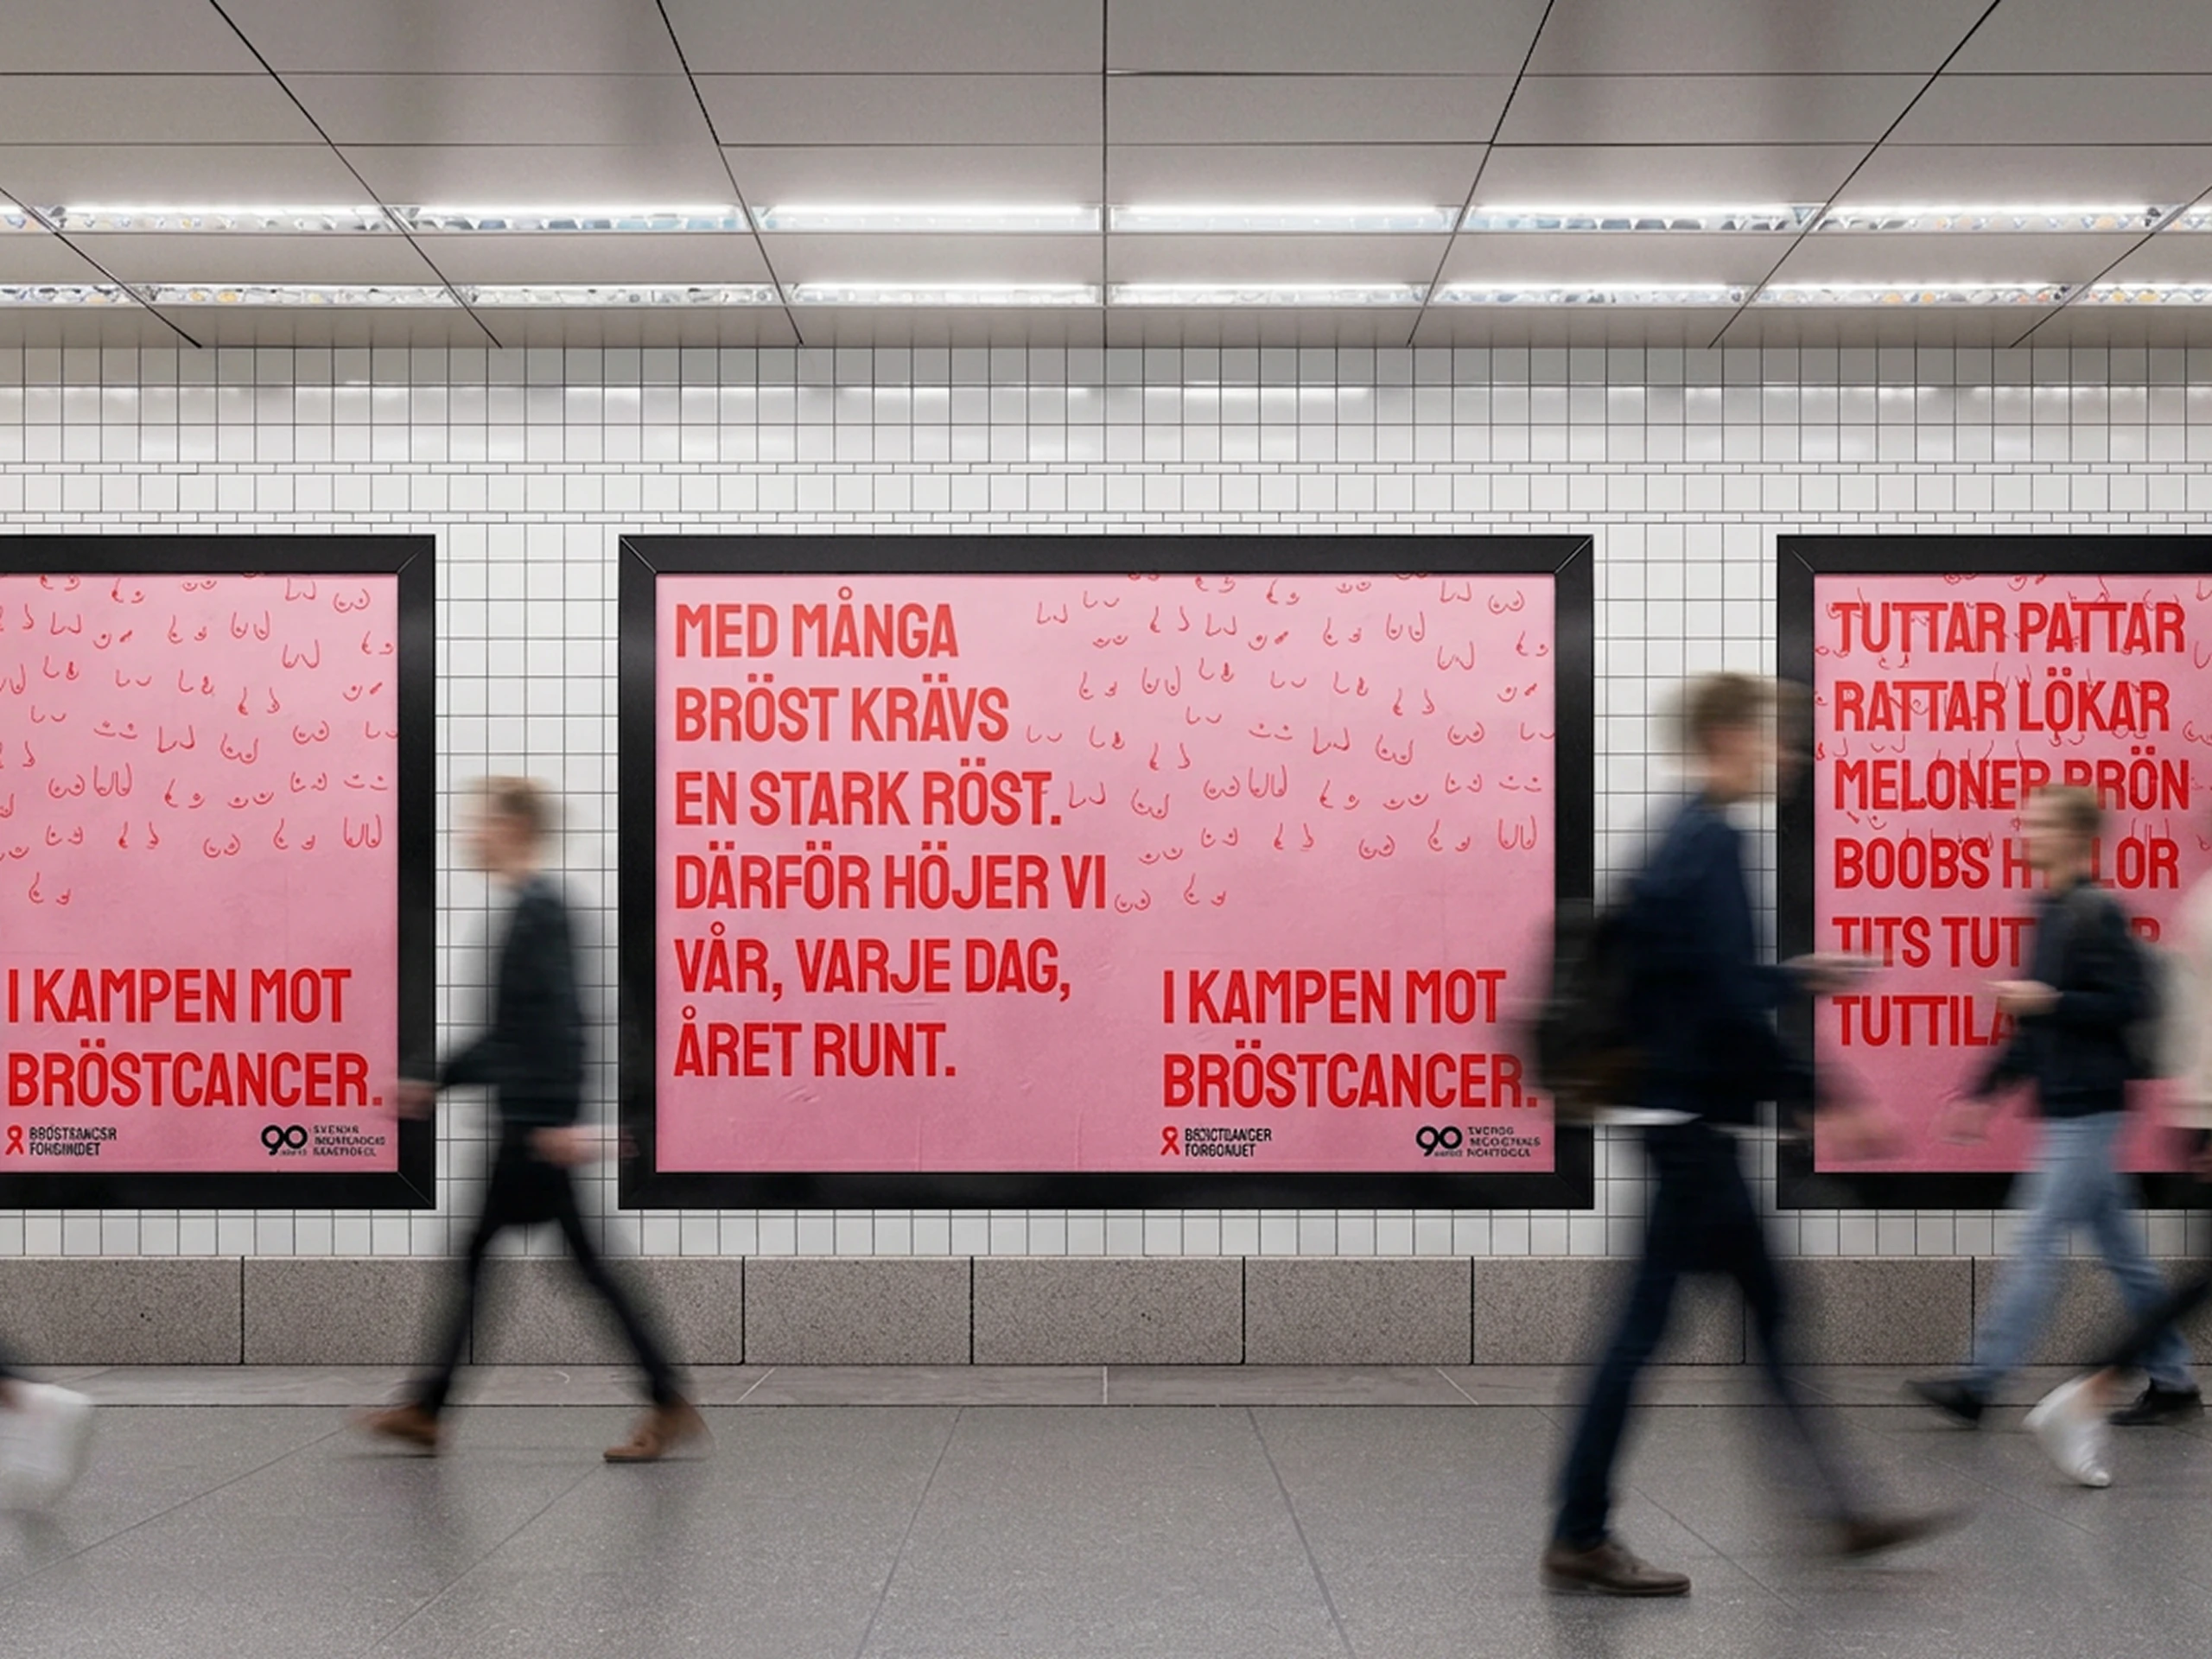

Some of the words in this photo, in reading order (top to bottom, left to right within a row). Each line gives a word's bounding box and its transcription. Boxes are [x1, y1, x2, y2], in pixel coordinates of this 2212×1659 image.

[676, 604, 778, 658] MED
[793, 586, 958, 658] MÅNGA
[1833, 602, 2006, 654] TUTTAR
[2018, 602, 2185, 654] PATTAR
[676, 673, 839, 741] BRÖST
[852, 673, 1009, 741] KRÄVS
[1834, 680, 2006, 732] RATTAR
[2018, 666, 2170, 733] LÖKAR
[675, 772, 738, 826] EN
[749, 771, 910, 826] STARK
[923, 757, 1062, 826] RÖST.
[676, 840, 871, 911] DÄRFÖR
[884, 840, 1050, 911] HÖJER
[1061, 855, 1106, 910] VI
[1834, 836, 1991, 890] BOOBS
[2002, 836, 2179, 889] HLOR
[674, 921, 784, 1001] VÅR,
[795, 938, 951, 994] VARJE
[965, 938, 1071, 1001] DAG,
[1832, 915, 1931, 969] TITS
[8, 968, 20, 1025] I
[33, 968, 237, 1025] KAMPEN
[250, 968, 353, 1025] MOT
[1163, 969, 1175, 1025] I
[1188, 969, 1392, 1025] KAMPEN
[1405, 968, 1507, 1026] MOT
[7, 1038, 383, 1109] BRÖSTCANCER.
[674, 1005, 803, 1077] ÅRET
[813, 1022, 957, 1077] RUNT.
[1163, 1038, 1538, 1110] BRÖSTCANCER.
